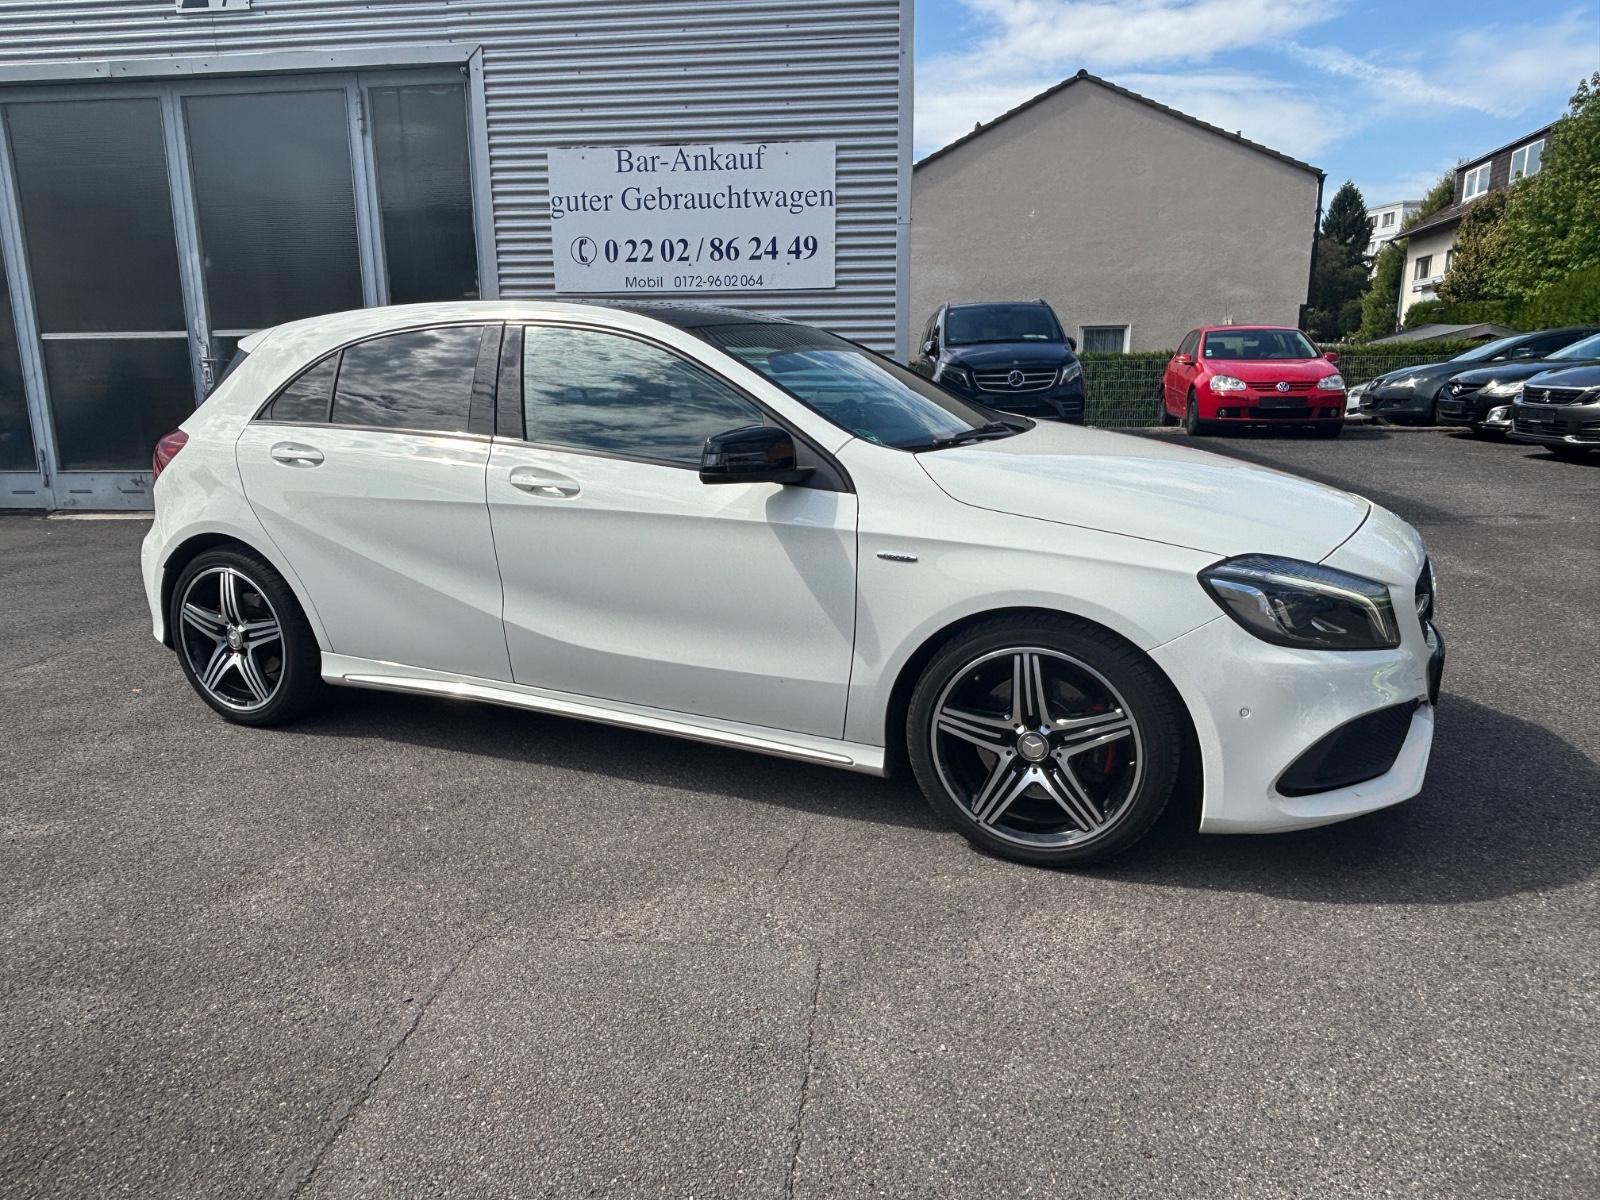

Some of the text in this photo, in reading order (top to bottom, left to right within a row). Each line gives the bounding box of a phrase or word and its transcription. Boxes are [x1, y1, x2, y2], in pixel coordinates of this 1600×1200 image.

[614, 144, 768, 174] Bar-Ankauf
[550, 184, 834, 220] guter Gebrauchtwagen
[625, 275, 664, 289] Mobil
